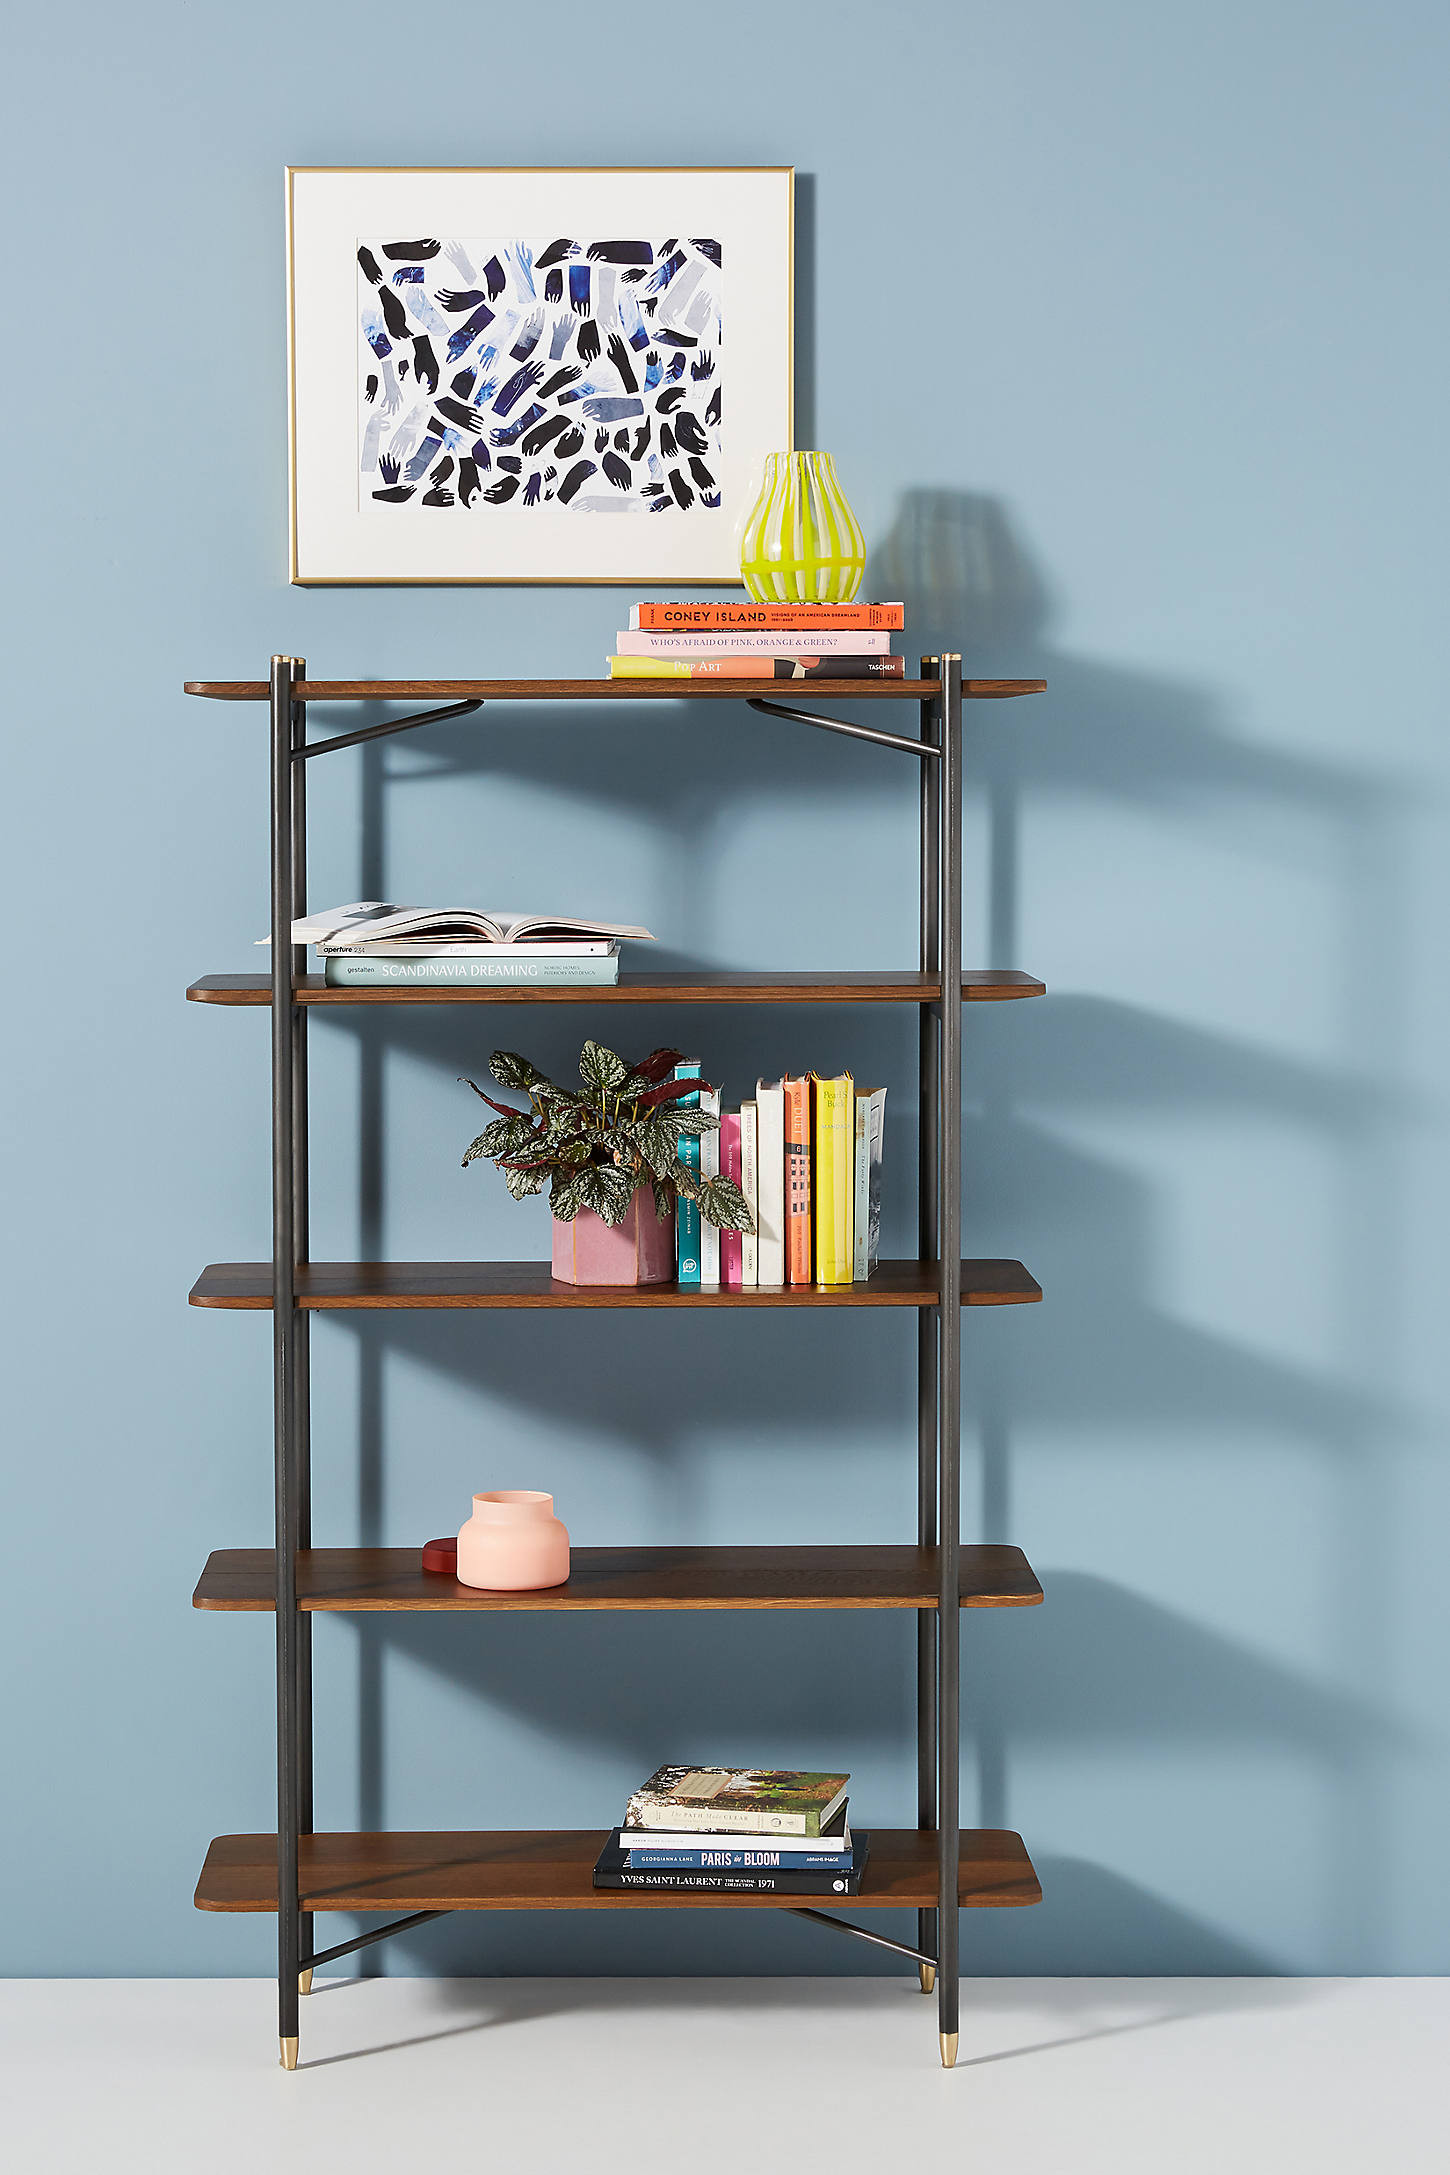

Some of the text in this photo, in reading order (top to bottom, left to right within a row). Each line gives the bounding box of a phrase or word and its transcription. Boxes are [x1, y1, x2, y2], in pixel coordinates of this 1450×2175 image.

[664, 611, 767, 622] CONEY ISLAND
[731, 639, 755, 647] PINK,
[347, 965, 375, 974] gestalten
[382, 964, 538, 977] SCANDINAVIA DREAMING
[793, 1107, 803, 1136] DUET
[686, 1137, 691, 1146] IN
[747, 1135, 752, 1143] OF
[701, 1852, 732, 1866] PARIS
[744, 1852, 780, 1866] BLOOM
[620, 1874, 723, 1887] YVES SAINT LAURENT
[758, 1879, 775, 1889] 1971
